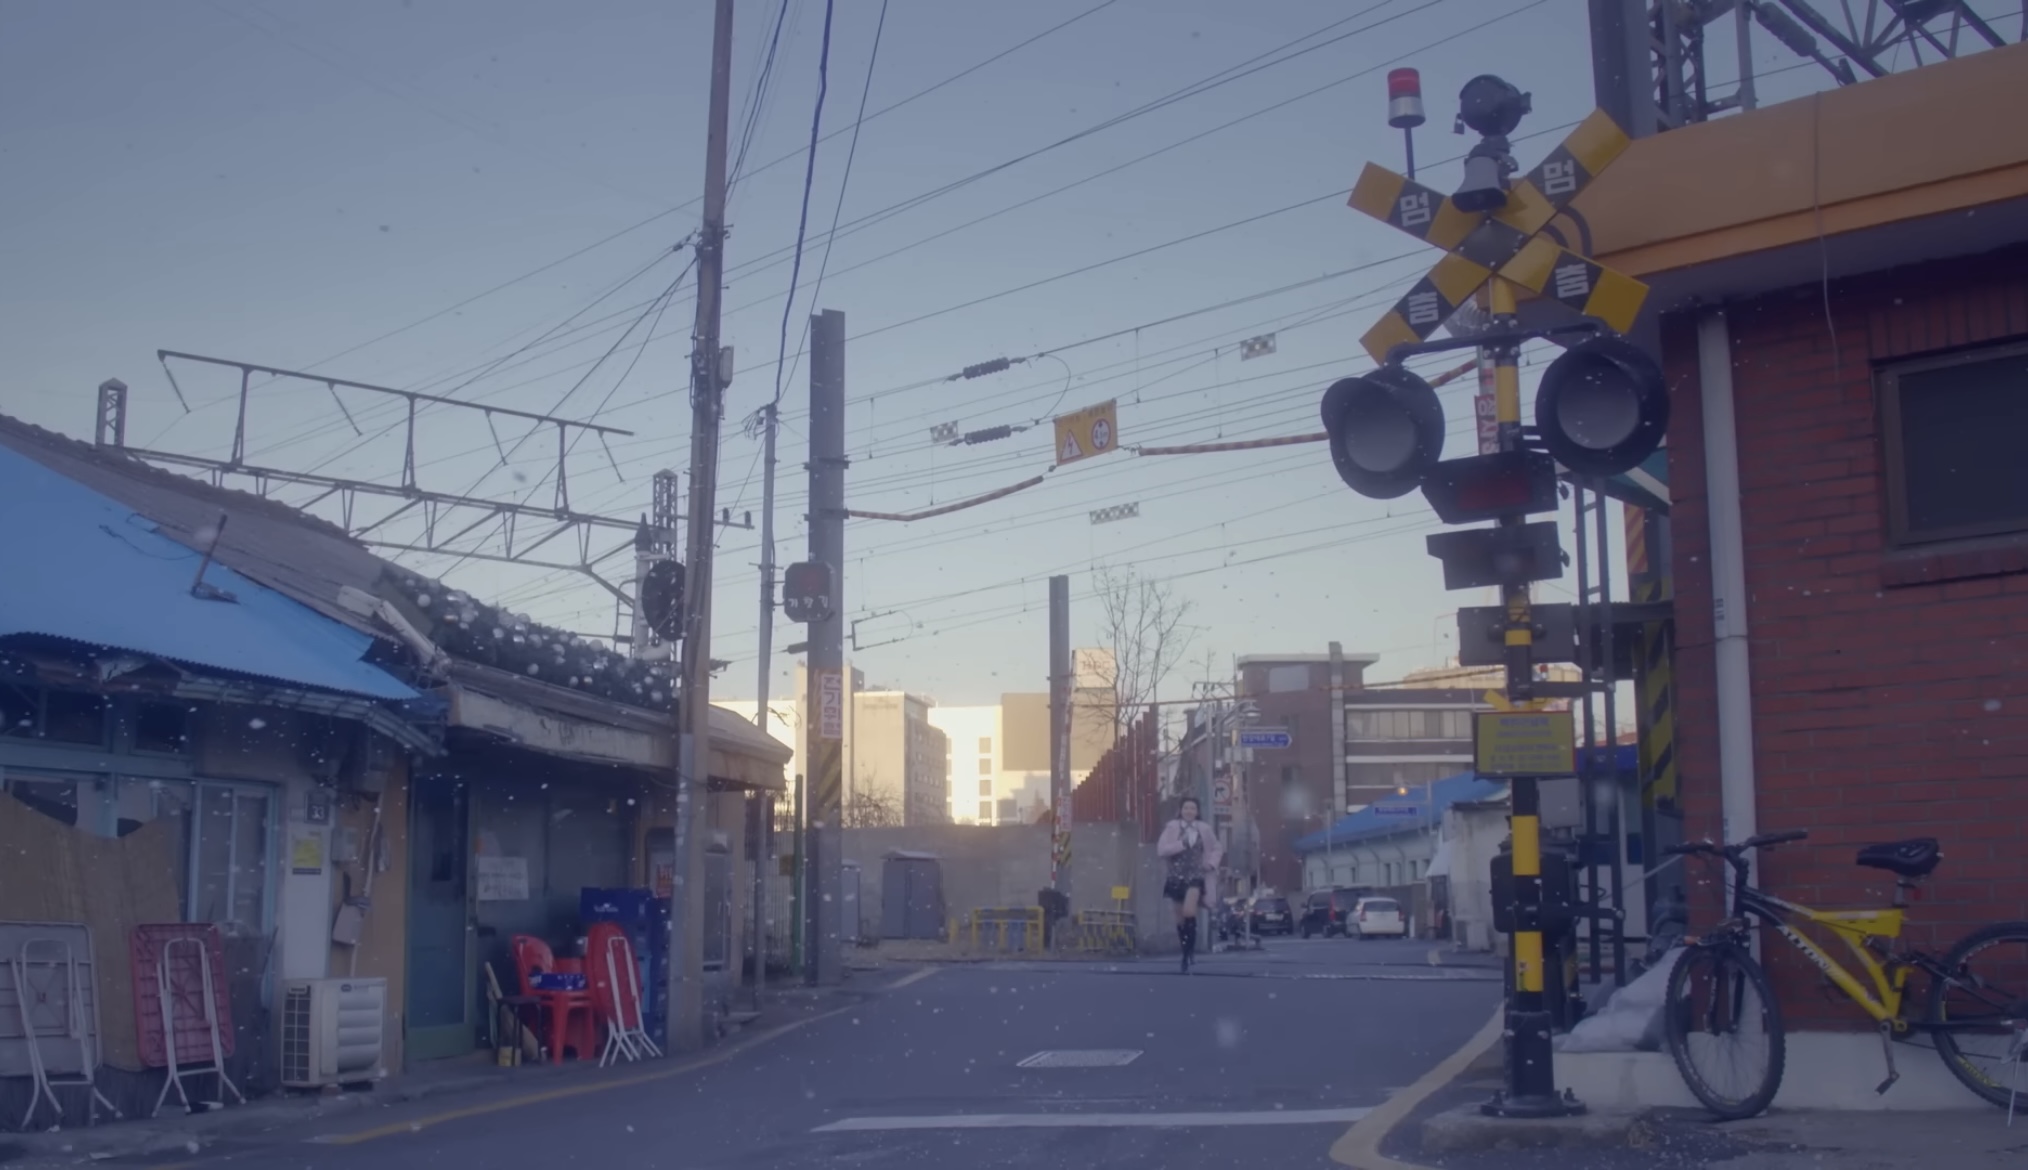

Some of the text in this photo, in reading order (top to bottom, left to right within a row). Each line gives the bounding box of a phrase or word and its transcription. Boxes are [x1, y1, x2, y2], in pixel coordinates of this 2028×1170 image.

[1542, 159, 1577, 195] 멈
[1399, 191, 1431, 228] 멈
[1554, 262, 1590, 299] 춤
[1408, 290, 1440, 326] 춤
[311, 804, 326, 820] 33
